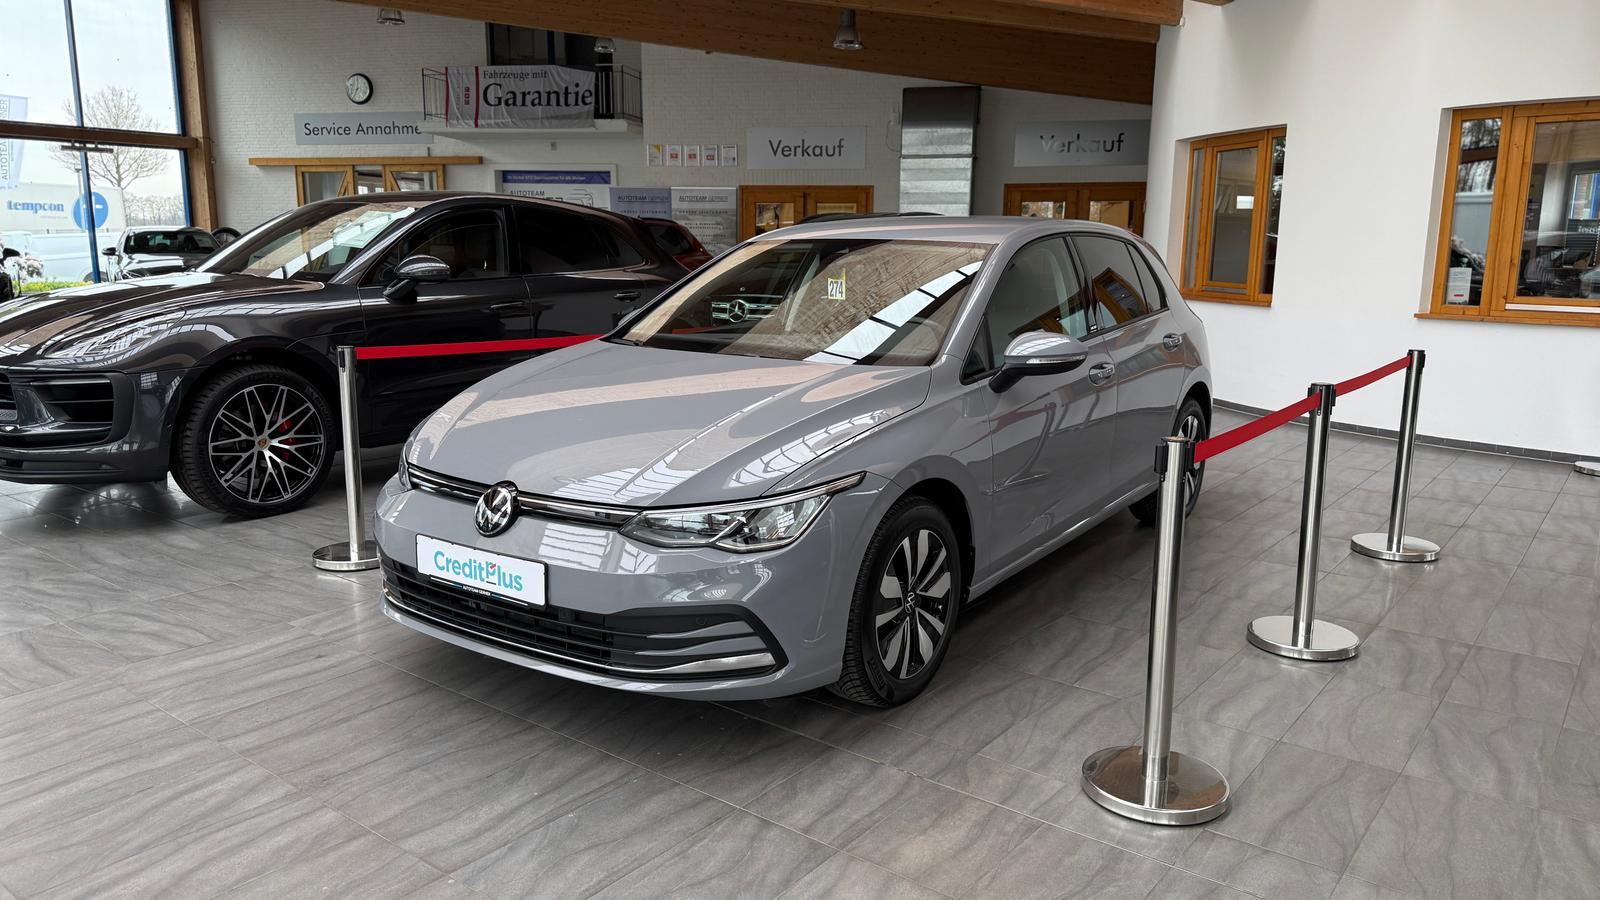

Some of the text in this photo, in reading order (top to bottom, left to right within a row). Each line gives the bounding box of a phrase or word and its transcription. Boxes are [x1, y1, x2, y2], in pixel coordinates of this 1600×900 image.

[483, 70, 548, 81] Fahrzeuge mit
[482, 82, 593, 107] Garantie
[303, 122, 352, 136] Service
[768, 138, 845, 157] Verkauf
[1039, 132, 1125, 153] Verkauf
[7, 200, 65, 214] tempcon
[829, 280, 844, 298] 274
[434, 550, 523, 591] CreditPlus
